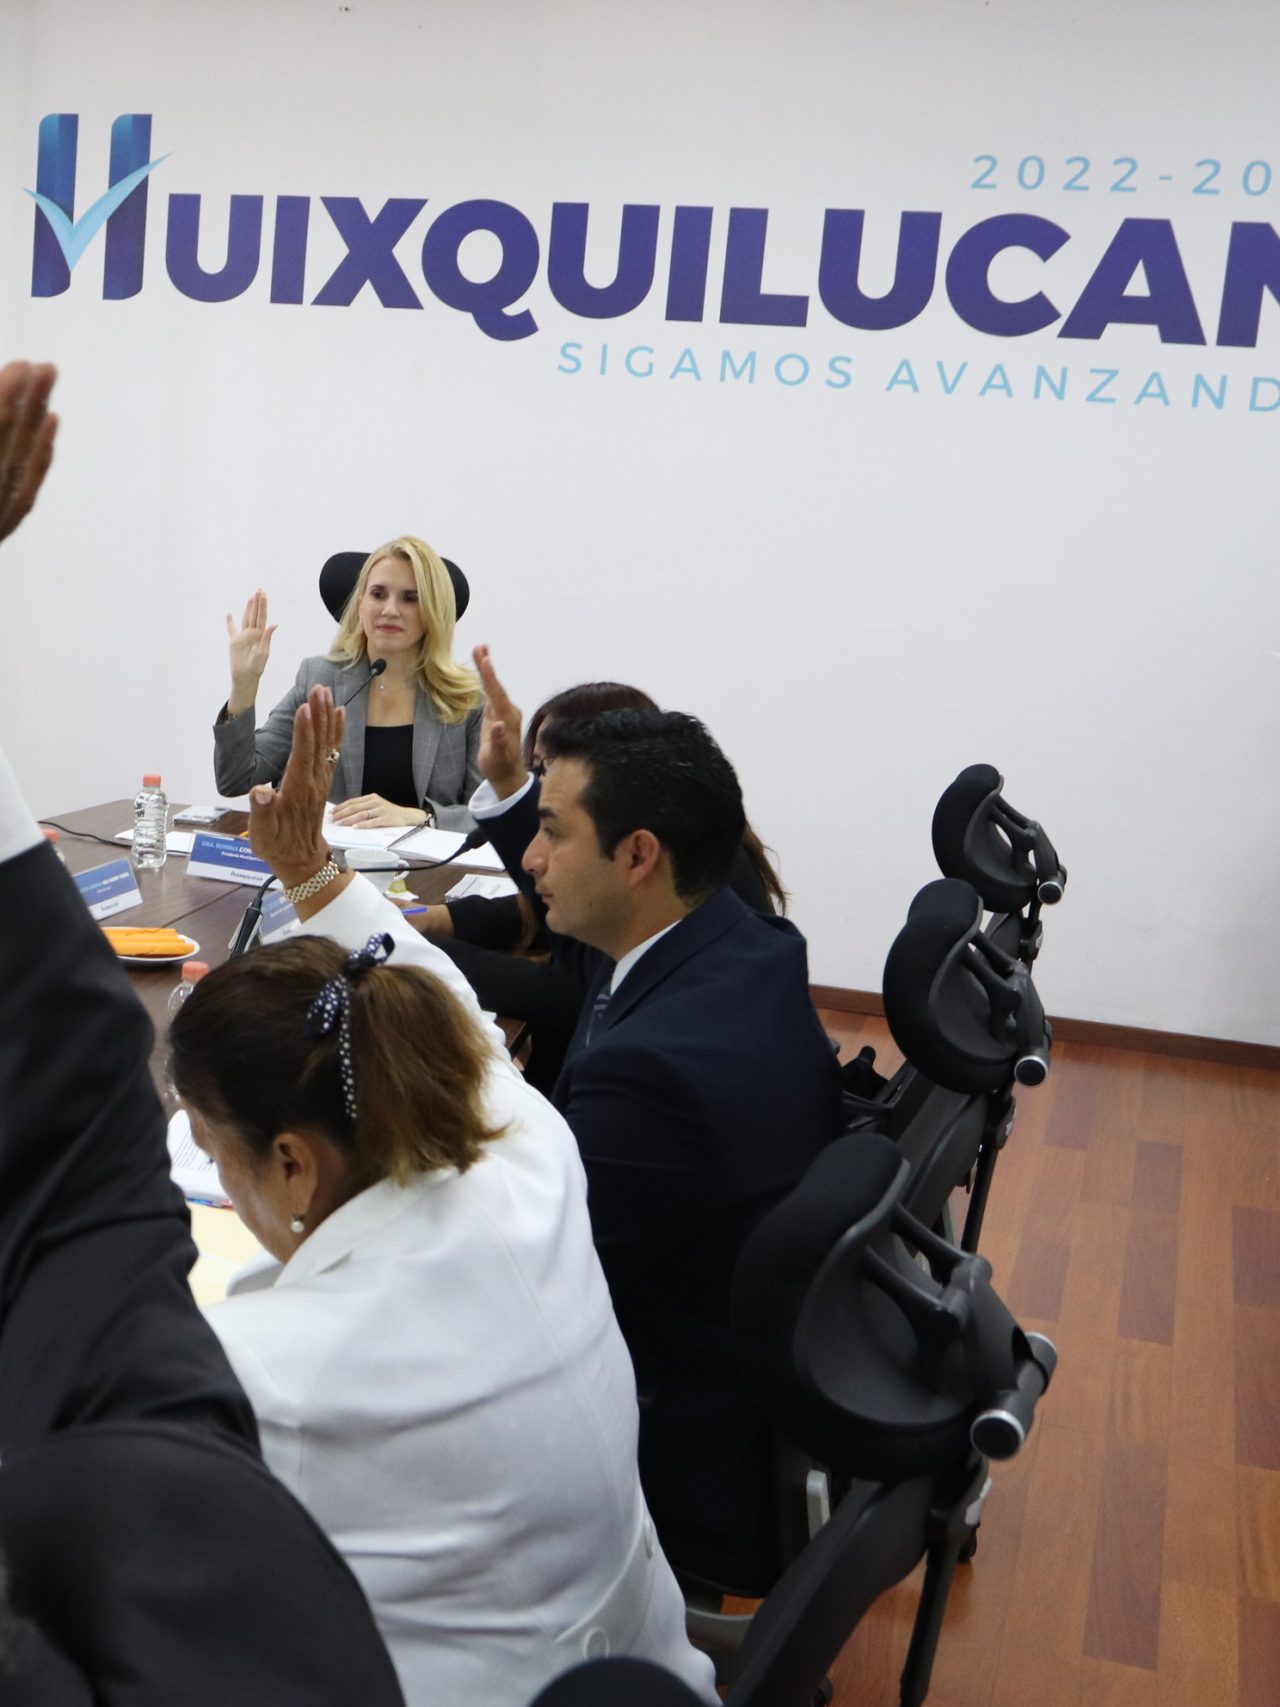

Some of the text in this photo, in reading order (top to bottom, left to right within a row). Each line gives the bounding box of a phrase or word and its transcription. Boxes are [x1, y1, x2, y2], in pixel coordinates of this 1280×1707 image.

[970, 154, 1274, 197] 2022-20
[559, 340, 1280, 413] SIGAMOS AVANZAND
